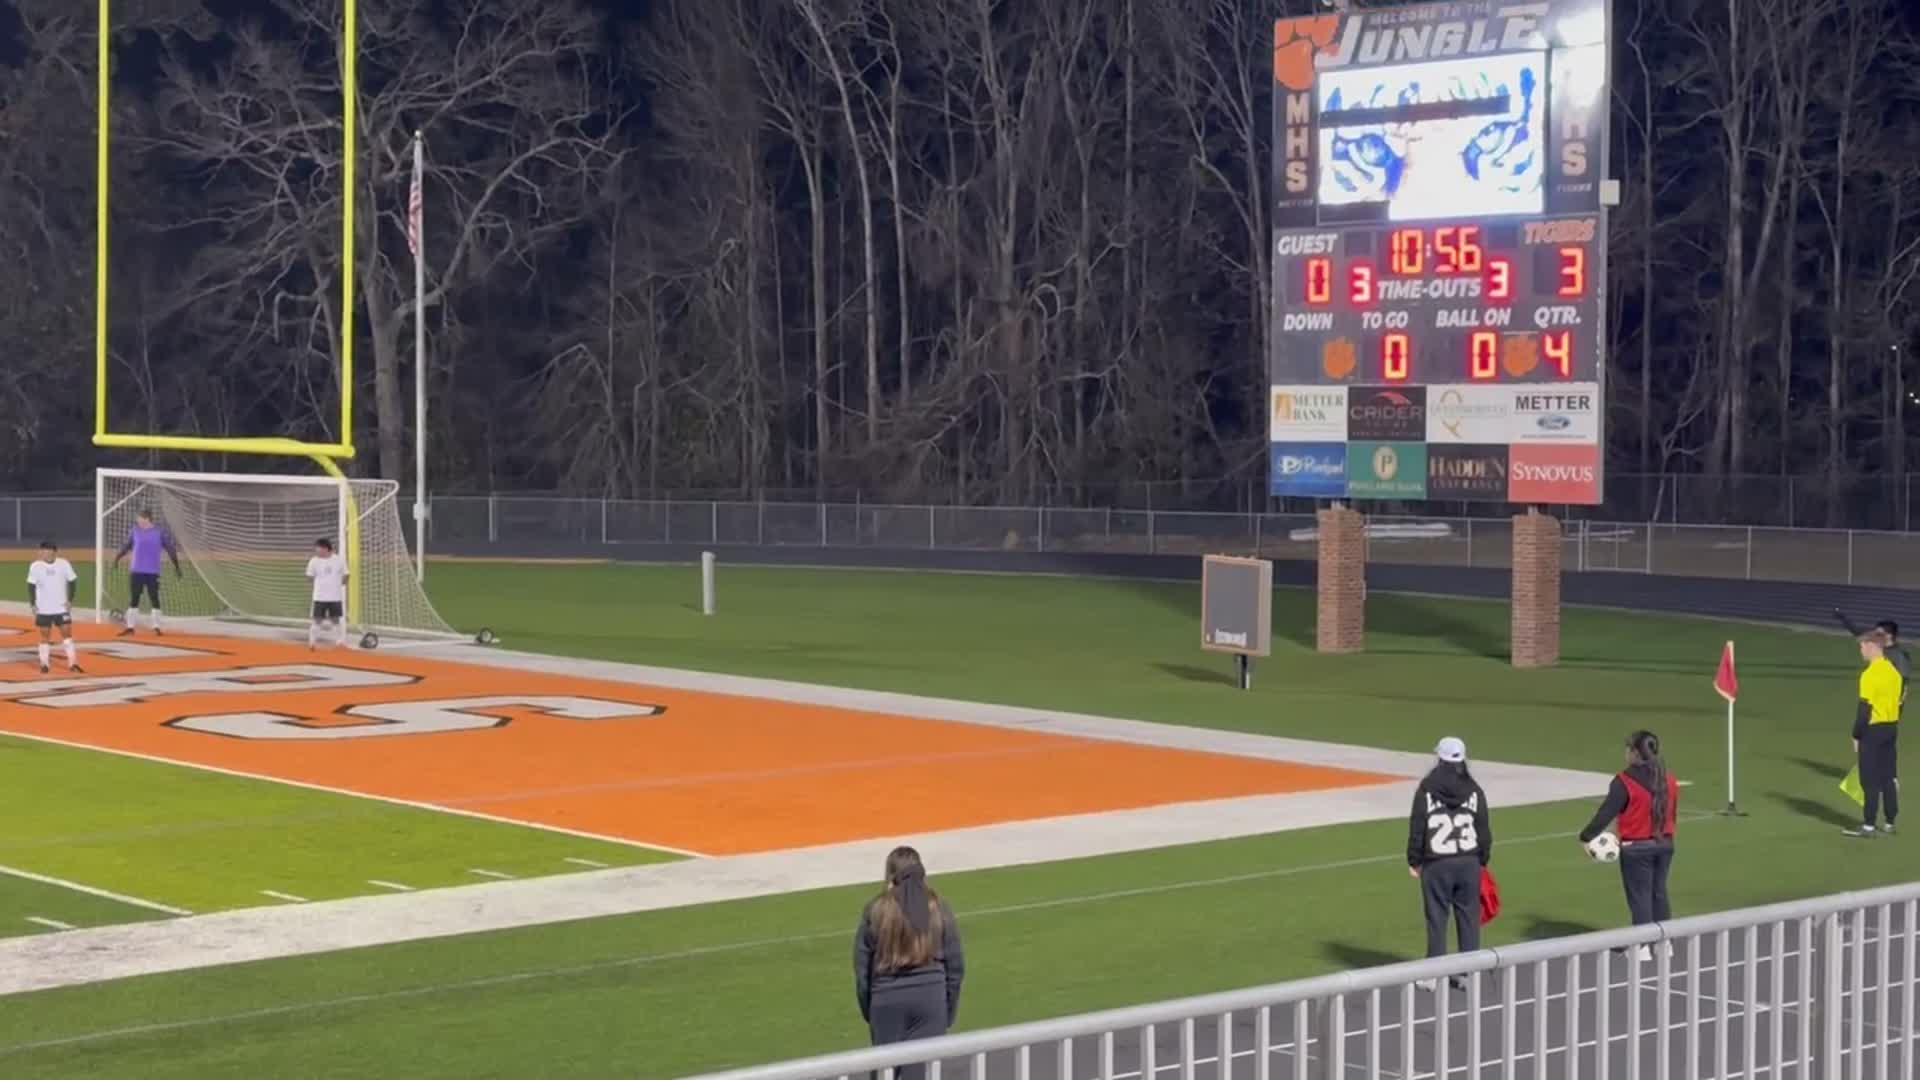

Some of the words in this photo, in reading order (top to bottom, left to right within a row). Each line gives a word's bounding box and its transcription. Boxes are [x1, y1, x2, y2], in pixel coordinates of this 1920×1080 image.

[1314, 3, 1549, 67] JUNGLE
[1286, 93, 1309, 192] MHS
[1277, 234, 1337, 255] GUEST
[1392, 227, 1482, 274] 10:56
[1307, 259, 1331, 303] 0
[1488, 261, 1509, 297] 3
[1558, 247, 1585, 295] 3
[1351, 267, 1372, 303] 3
[1377, 279, 1482, 300] TIME-OUTS
[1283, 313, 1333, 331] DOWN
[1362, 312, 1385, 329] TO
[1385, 311, 1409, 329] GO
[1436, 310, 1479, 328] BALL
[1484, 308, 1511, 326] ON
[1534, 306, 1582, 328] QTR.
[1384, 334, 1408, 380] 0
[1472, 331, 1496, 379] 0
[1543, 331, 1570, 377] 4
[1294, 393, 1344, 407] METTER
[1514, 395, 1591, 411] METTER
[1294, 408, 1327, 421] BANK
[1350, 404, 1424, 421] CRIDER
[1429, 456, 1506, 478] HADDEN
[1512, 461, 1595, 483] SYNOVUS
[1427, 813, 1478, 854] 23
